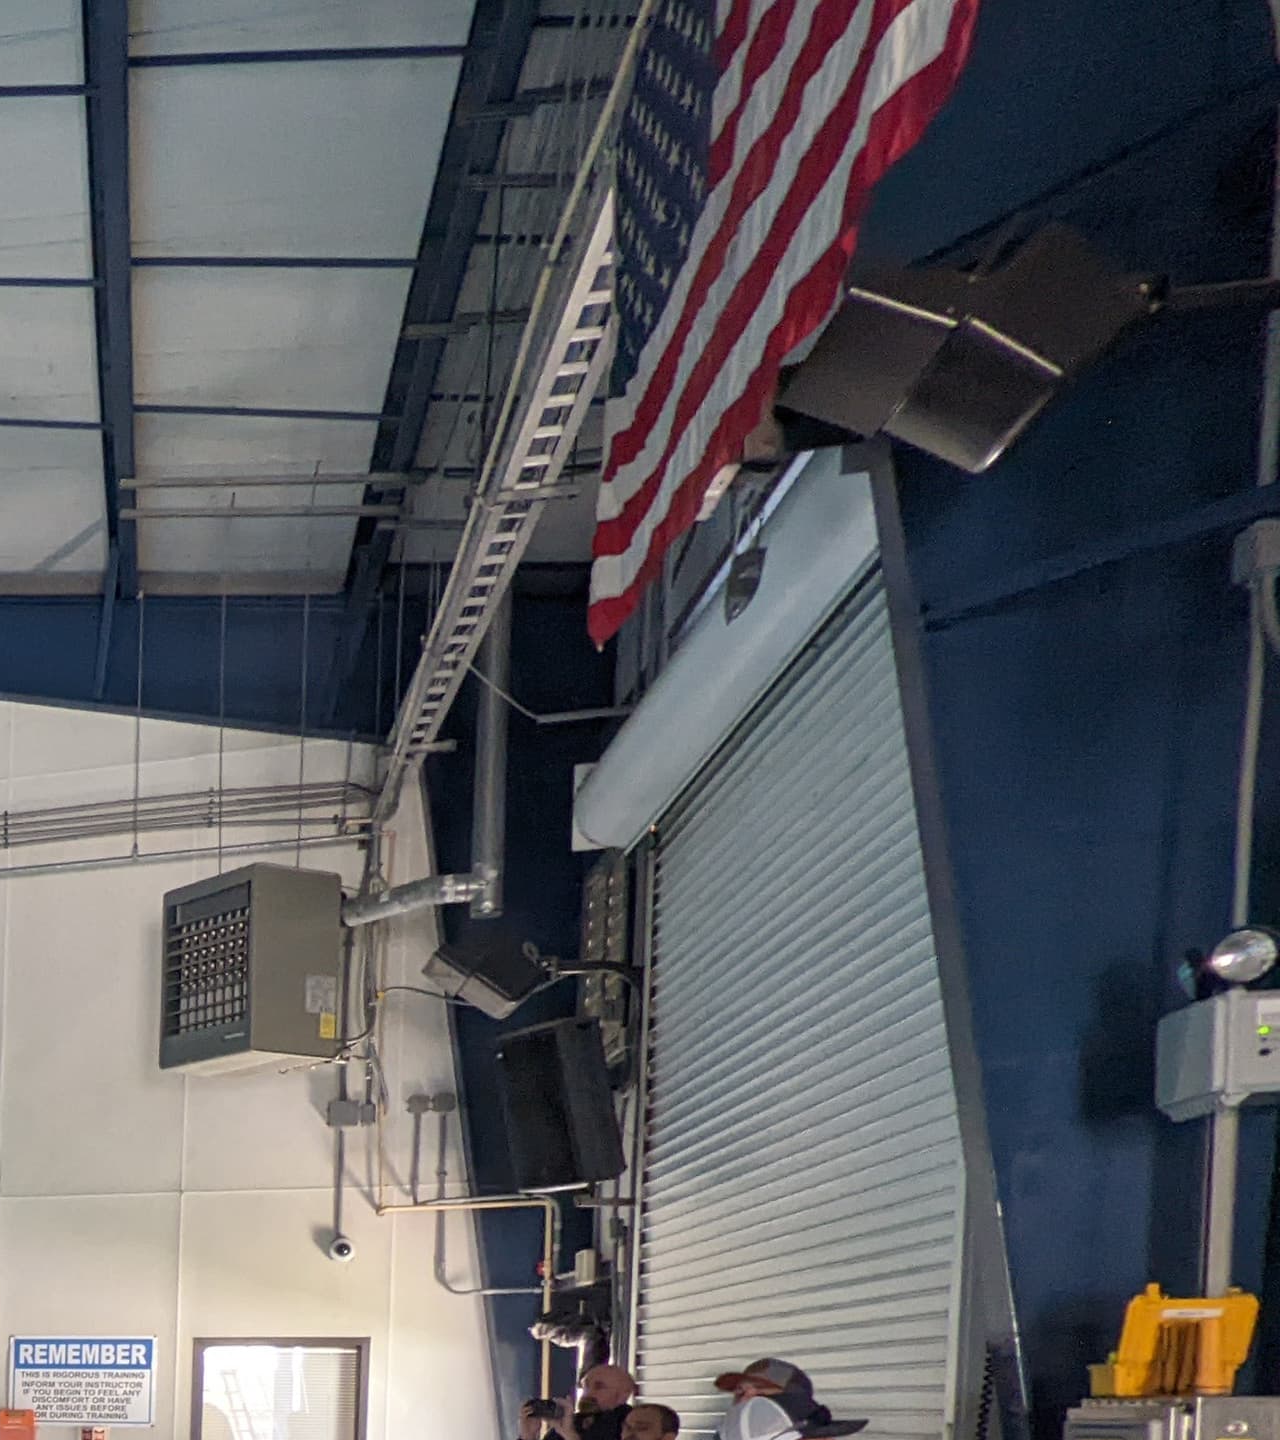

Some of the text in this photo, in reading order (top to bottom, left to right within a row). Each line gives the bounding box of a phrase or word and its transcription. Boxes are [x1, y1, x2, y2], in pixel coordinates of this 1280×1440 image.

[19, 1343, 147, 1365] REMEMBER
[52, 1371, 100, 1379] RIGOROUS
[57, 1381, 83, 1389] YOUR
[85, 1381, 143, 1389] INSTRUCTOR
[32, 1396, 91, 1404] DISCOMFORT
[35, 1411, 48, 1419] OR
[86, 1412, 128, 1420] TRAINING
